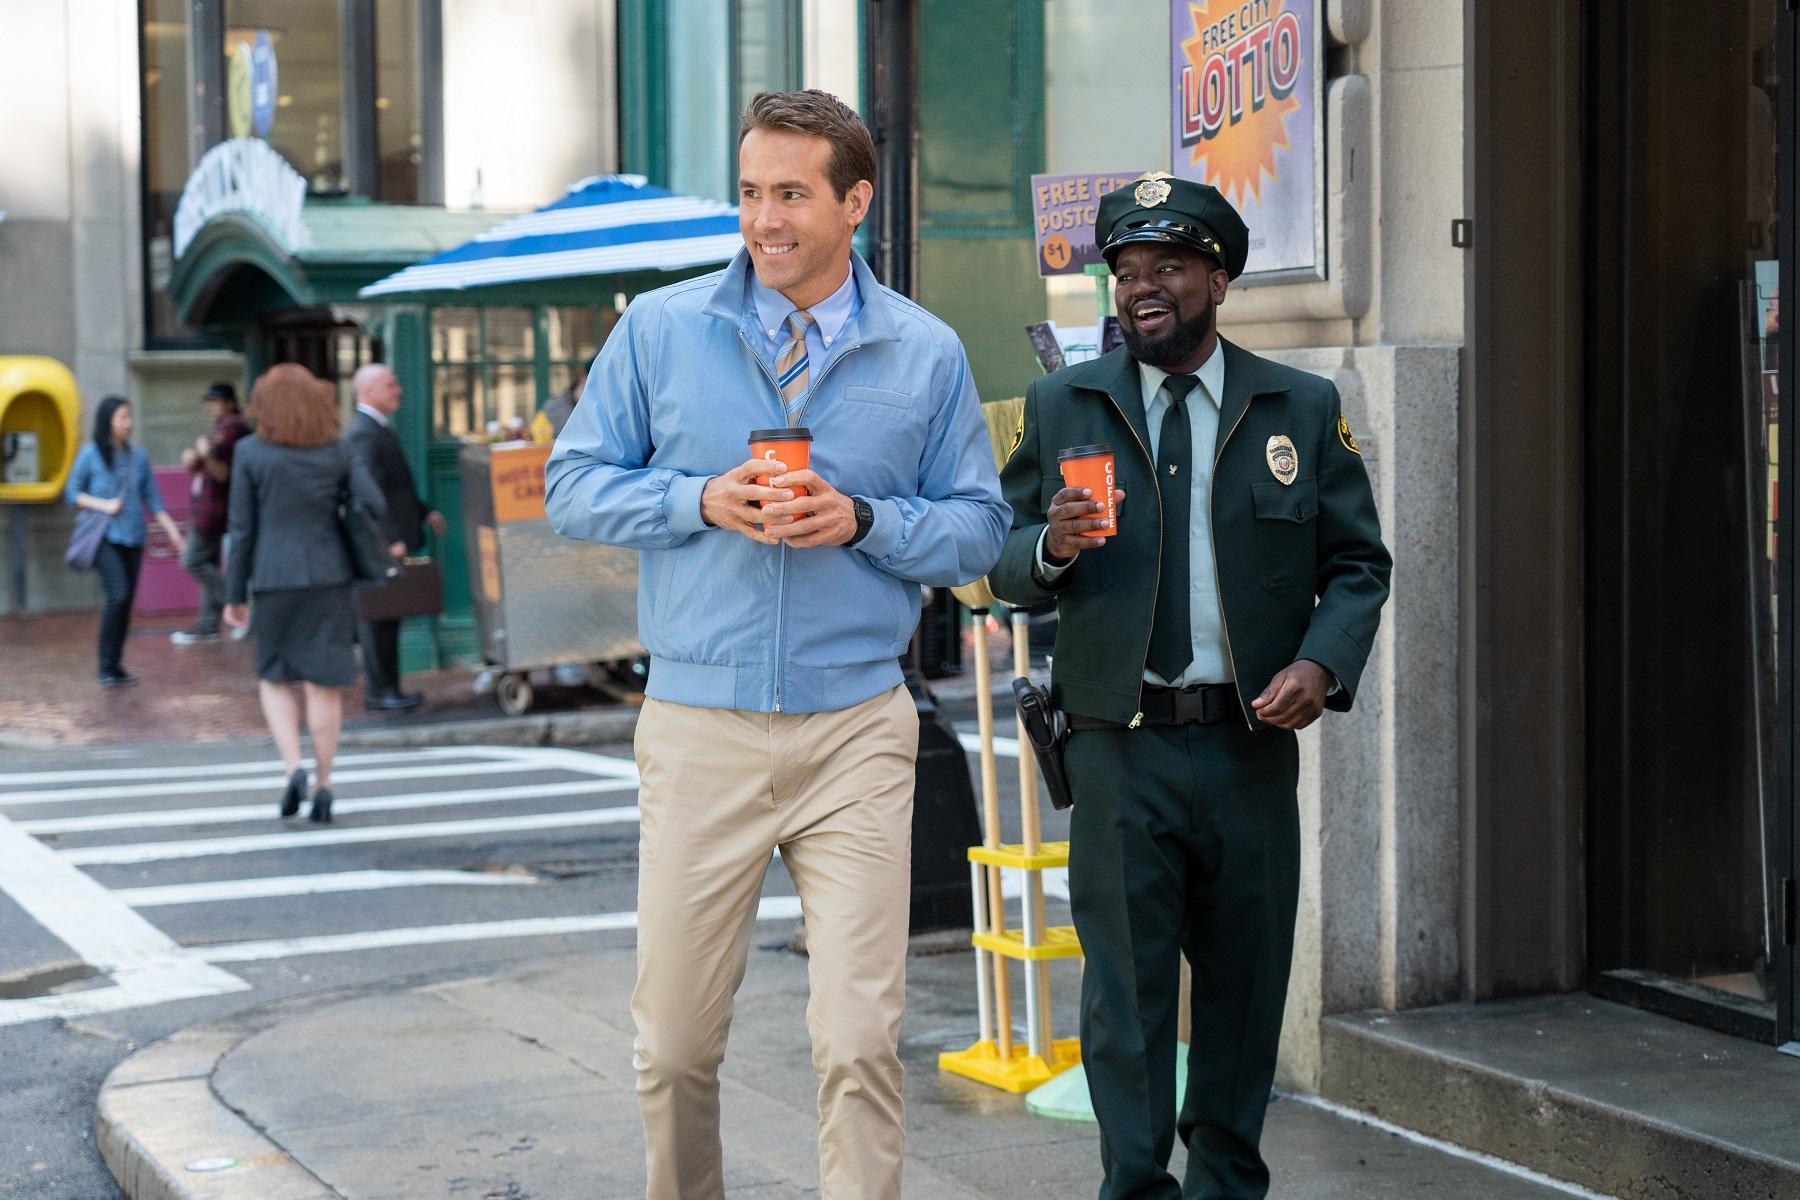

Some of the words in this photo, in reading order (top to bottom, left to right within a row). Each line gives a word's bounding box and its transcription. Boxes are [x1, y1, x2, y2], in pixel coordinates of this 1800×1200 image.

[1202, 13, 1236, 55] FREE
[1240, 0, 1269, 31] CITY
[1181, 10, 1301, 145] LOTTO
[1038, 178, 1091, 210] FREE
[1095, 178, 1129, 199] CI
[1038, 205, 1096, 235] POSTC
[1048, 243, 1065, 261] $1
[1104, 461, 1115, 529] COFFEE
